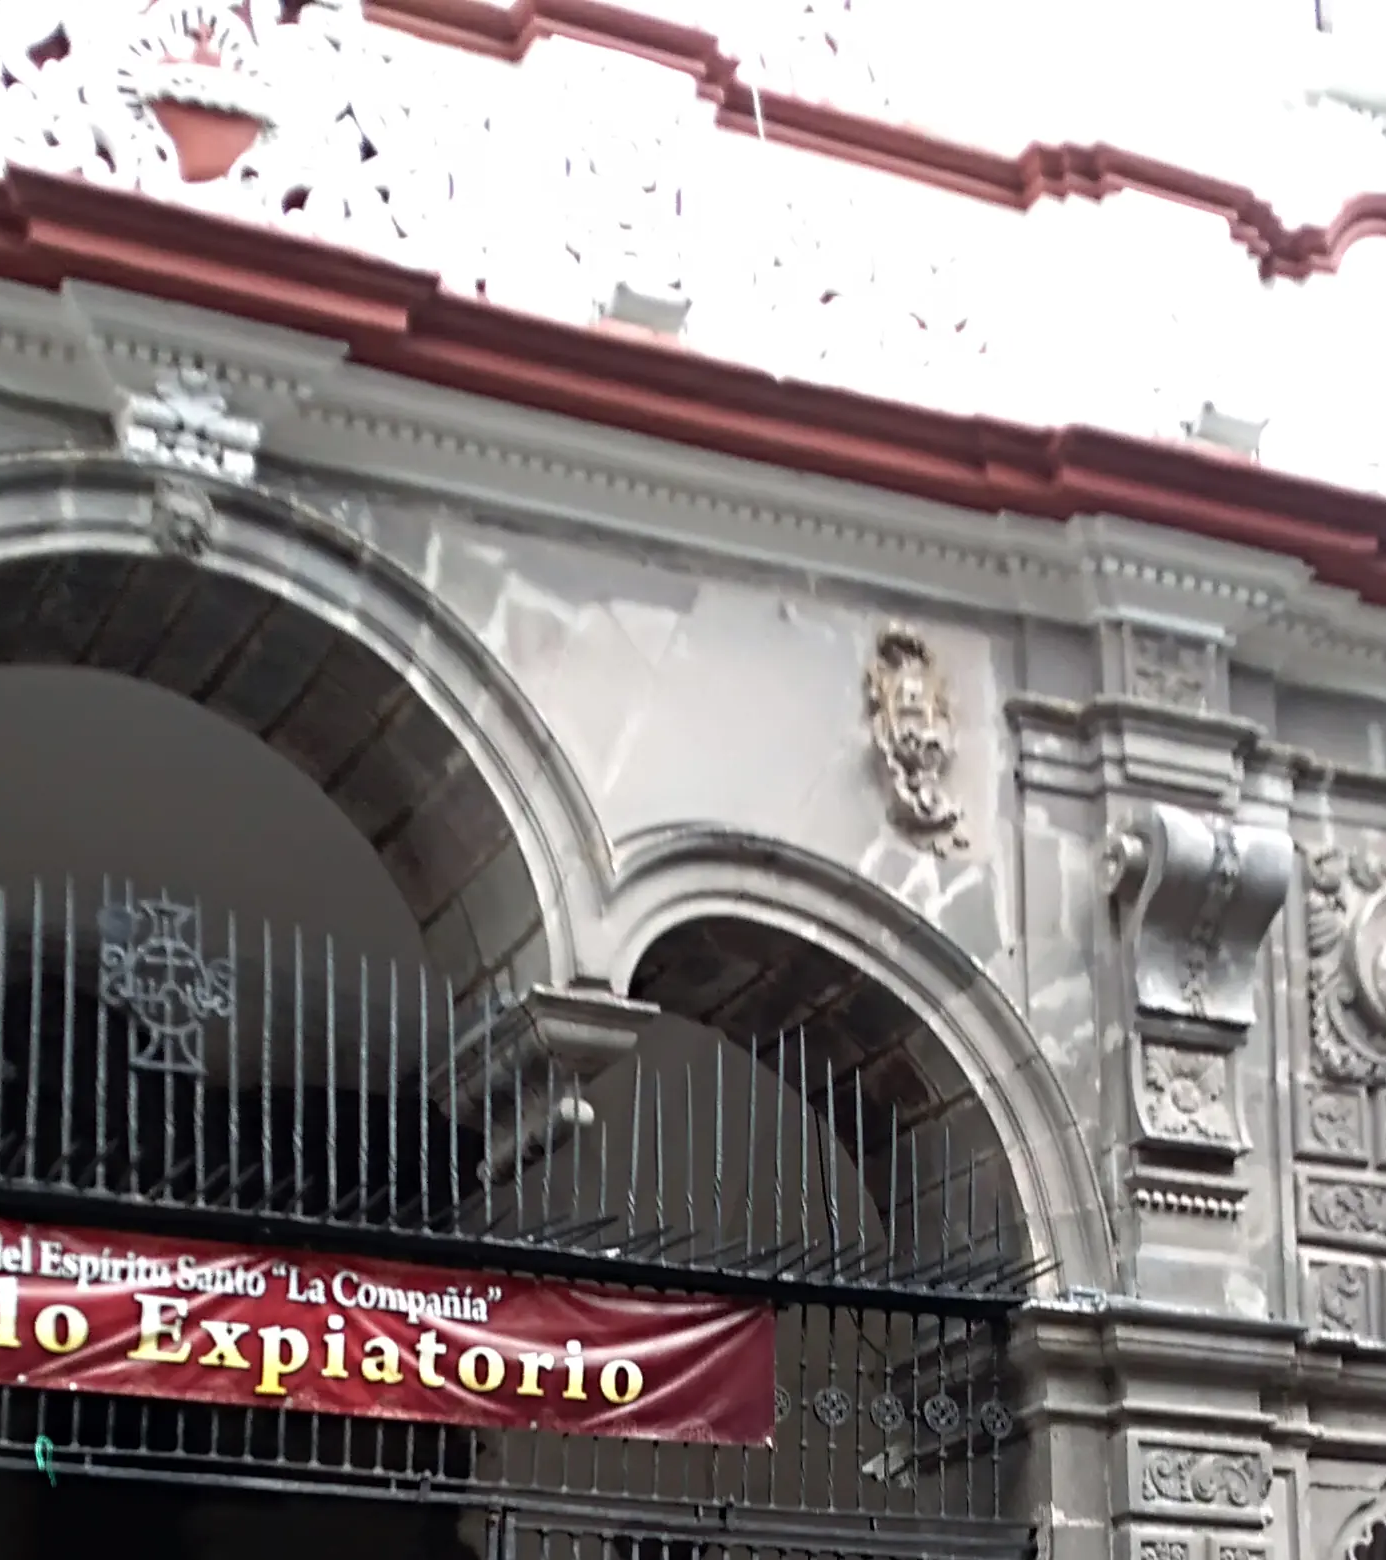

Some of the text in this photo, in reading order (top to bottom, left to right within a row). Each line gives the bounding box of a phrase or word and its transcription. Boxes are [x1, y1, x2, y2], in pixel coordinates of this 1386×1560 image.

[39, 1240, 171, 1290] Espíritu
[176, 1255, 266, 1298] Santo
[126, 1293, 644, 1405] Expiatorio
